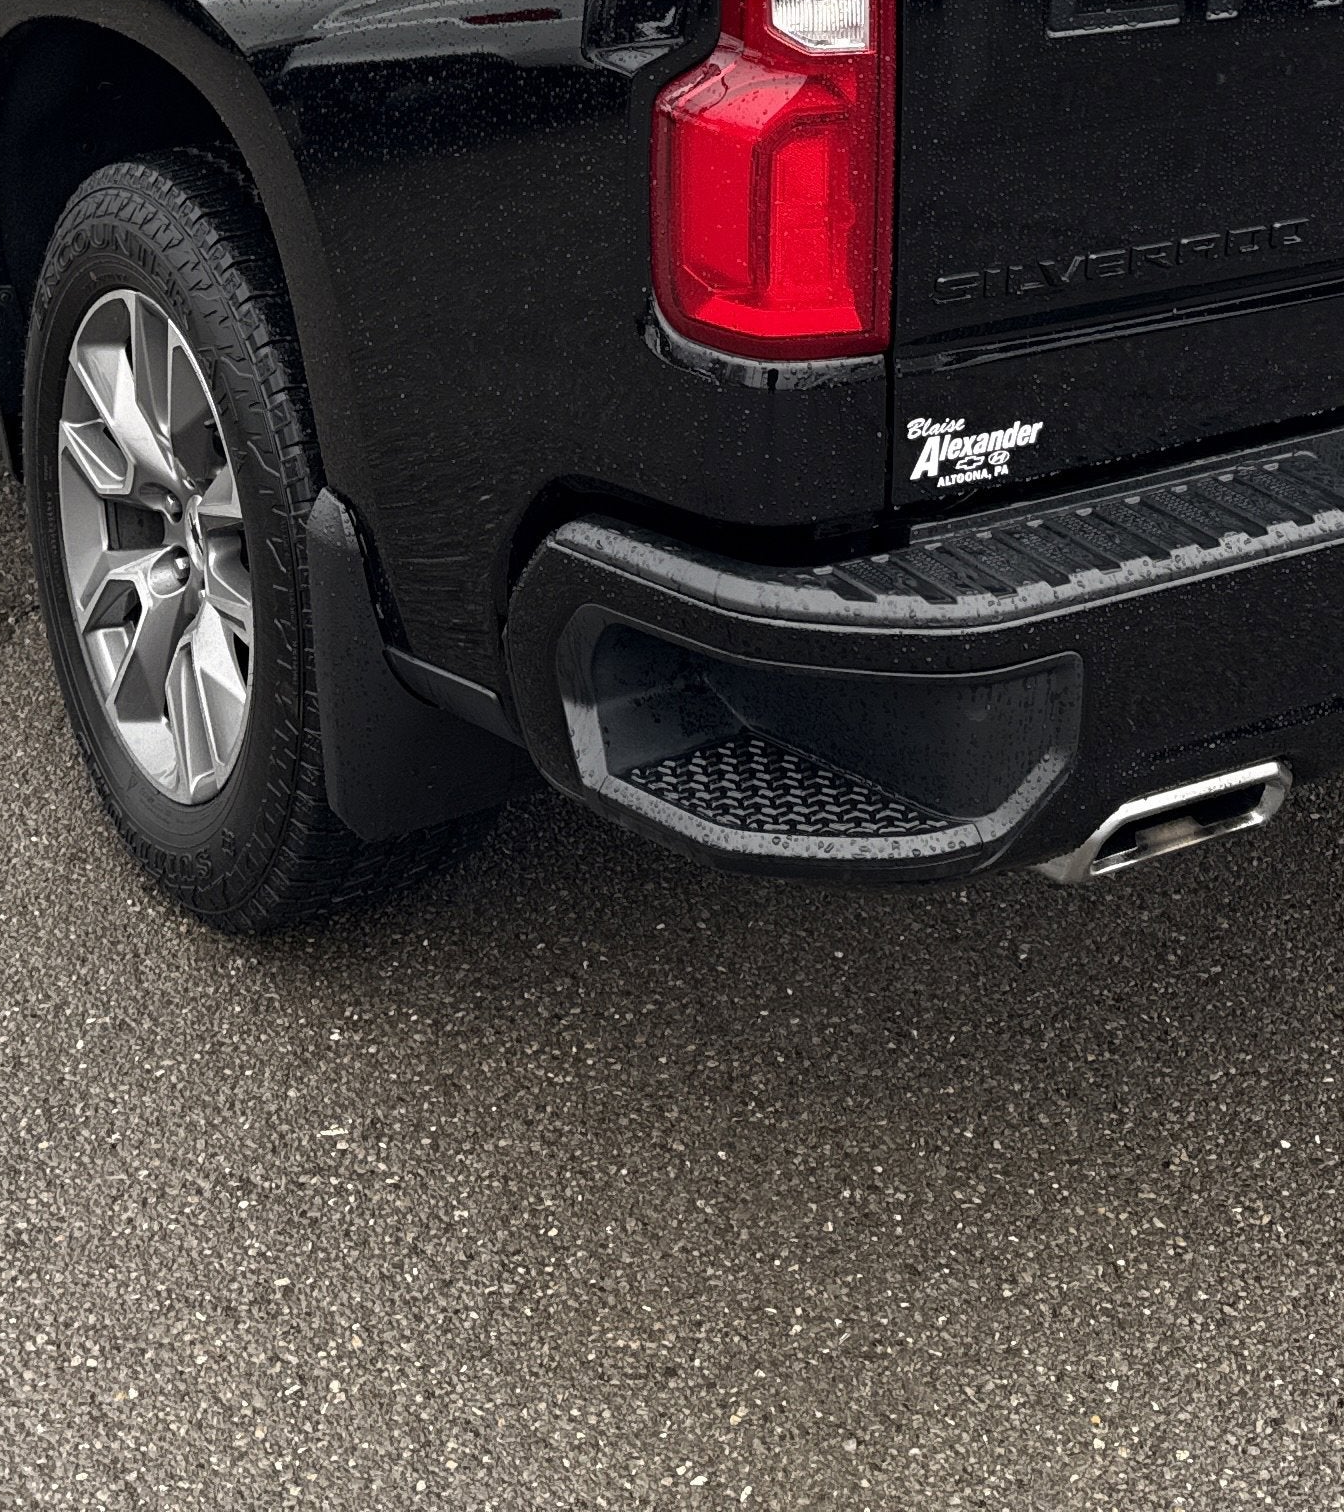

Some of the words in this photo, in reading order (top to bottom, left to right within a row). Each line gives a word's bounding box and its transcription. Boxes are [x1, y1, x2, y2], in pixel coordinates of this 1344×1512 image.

[930, 217, 1310, 305] SILVERADO
[906, 417, 966, 440] Blaise
[909, 420, 1044, 481] Alexander
[936, 467, 992, 488] ALTOONA,
[994, 464, 1009, 477] PA
